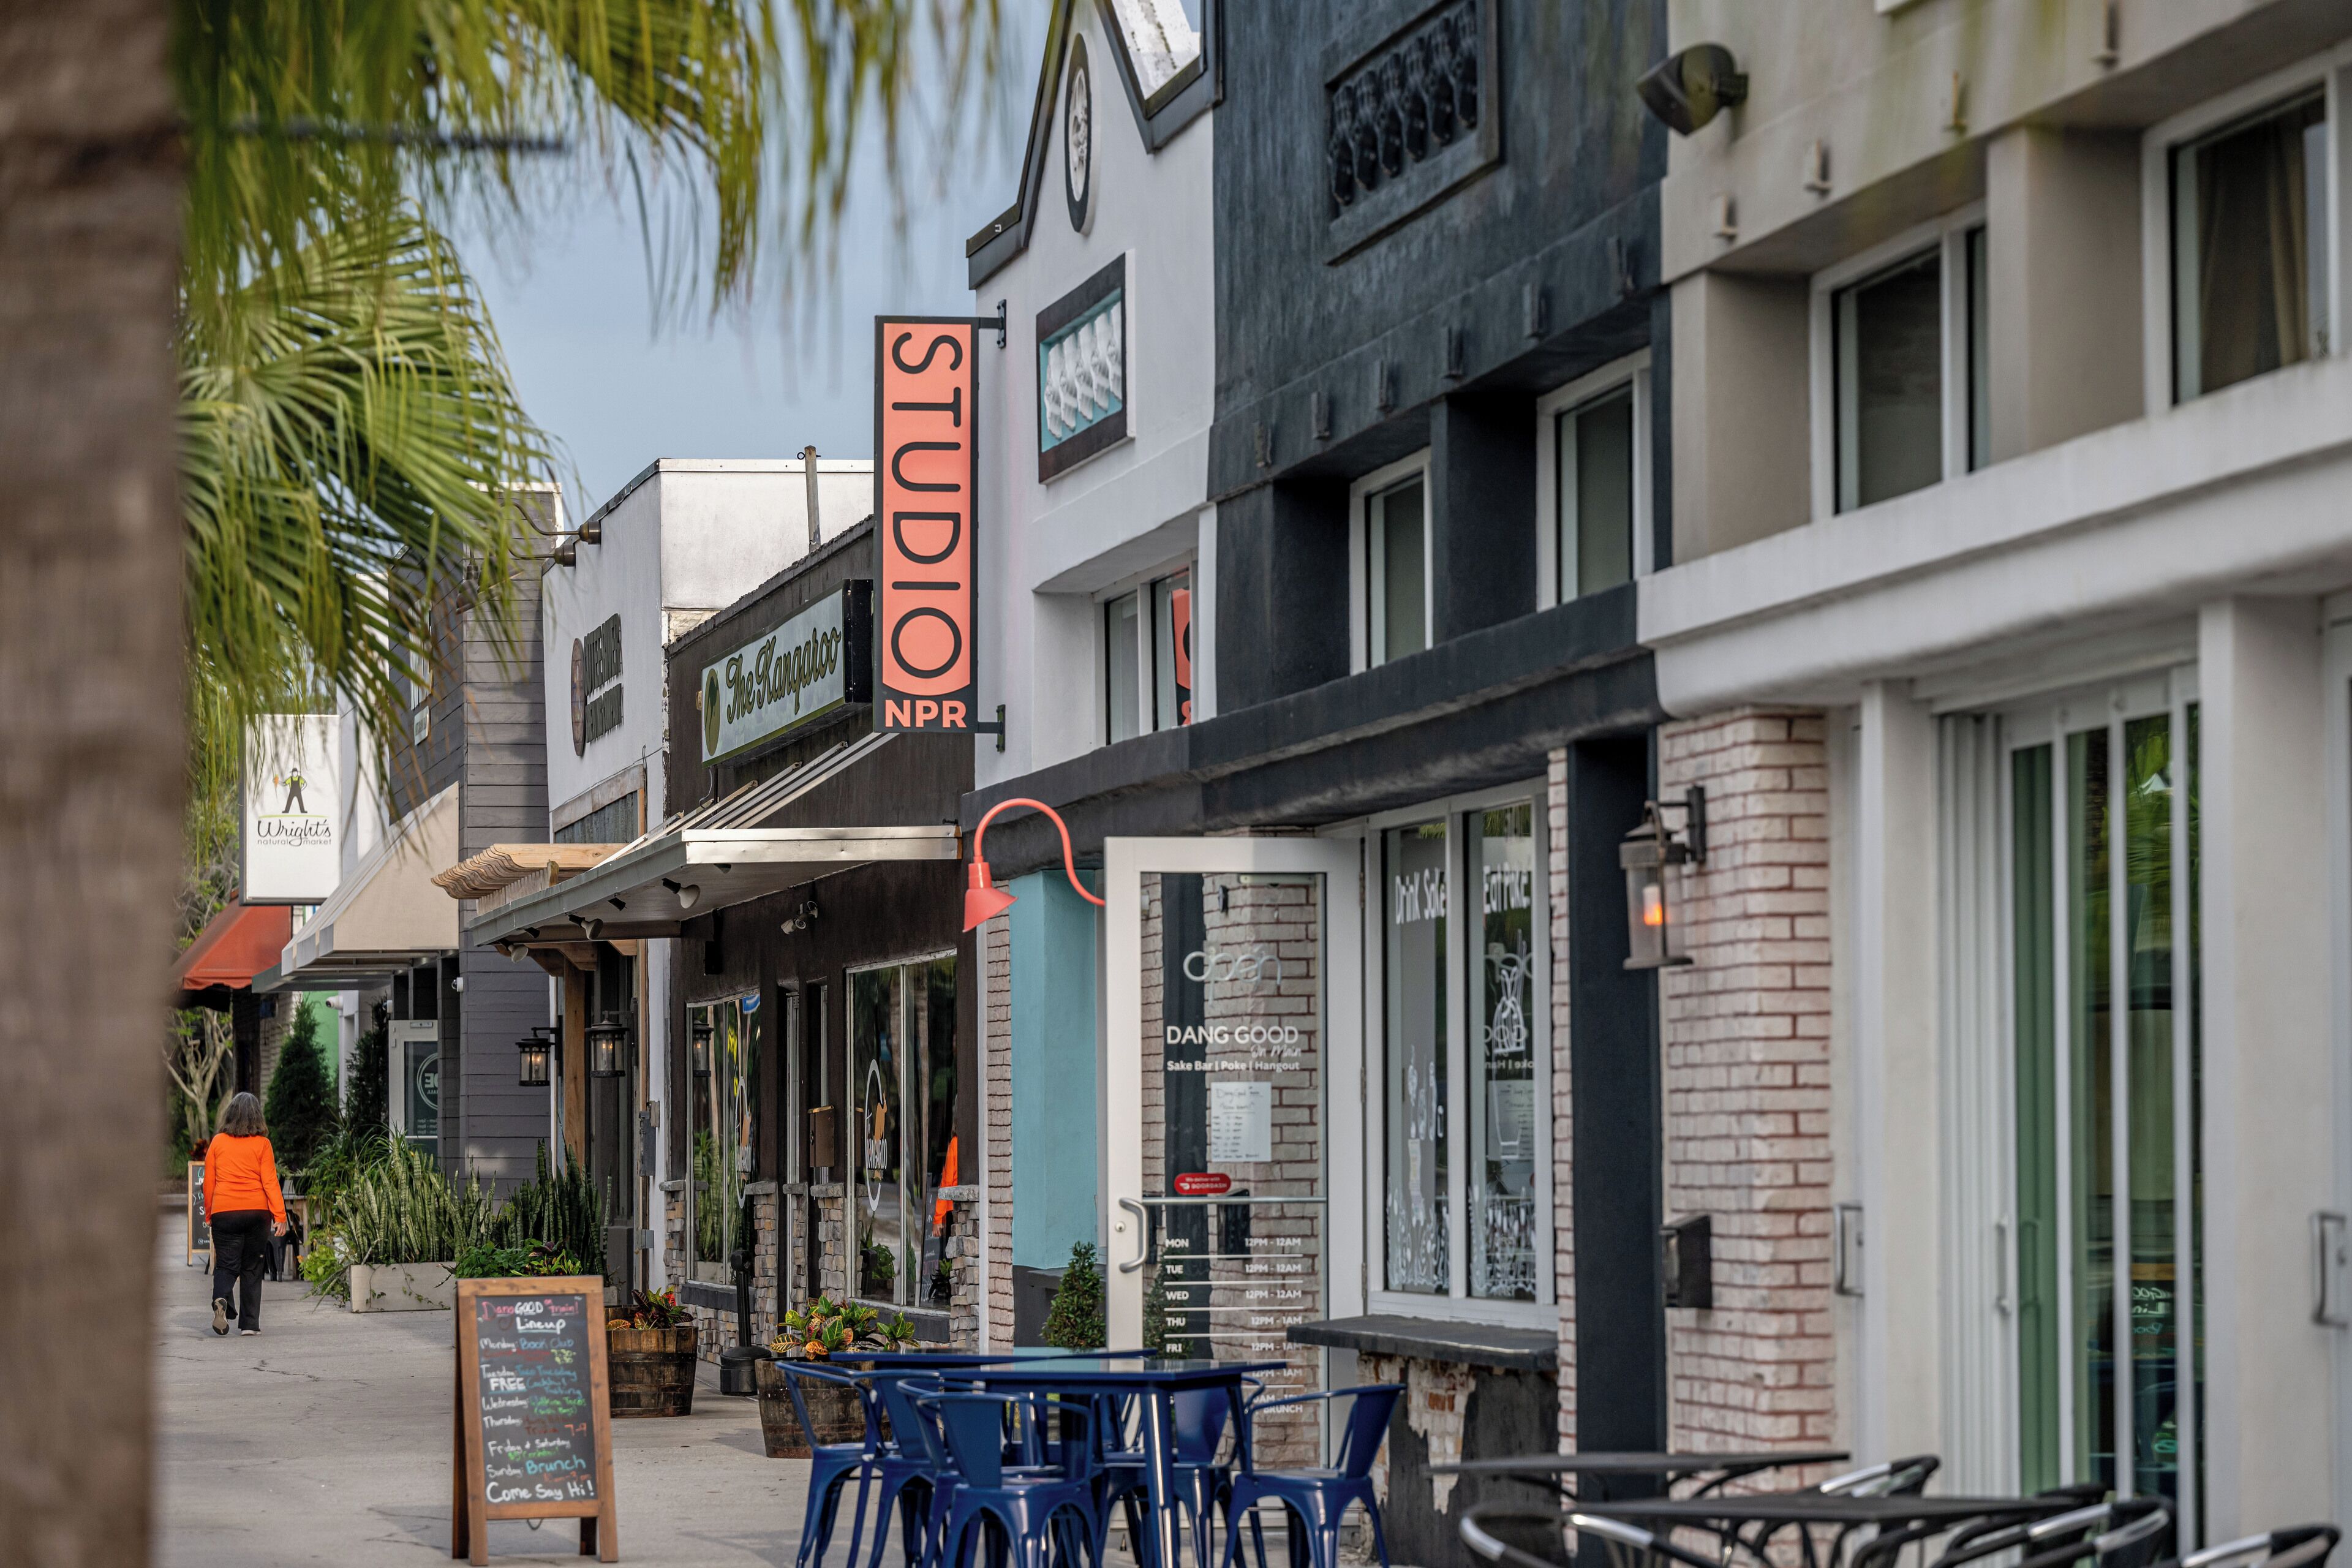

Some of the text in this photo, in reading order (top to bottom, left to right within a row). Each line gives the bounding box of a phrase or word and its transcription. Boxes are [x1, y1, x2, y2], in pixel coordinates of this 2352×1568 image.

[891, 331, 962, 678] STUDIO
[725, 627, 842, 724] The Kangaroo
[885, 699, 967, 728] NPR
[257, 819, 331, 846] Wright's
[1183, 951, 1282, 1008] open
[1166, 1025, 1299, 1044] DANG GOOD
[1270, 1044, 1302, 1058] Main
[1167, 1060, 1193, 1071] Sake
[1194, 1060, 1213, 1071] Bar
[1221, 1061, 1247, 1071] Poke
[1255, 1061, 1300, 1072] Hangout
[867, 1139, 888, 1169] KANGAROO
[1165, 1238, 1189, 1248] MON
[1245, 1238, 1268, 1247] 12PM
[1276, 1237, 1301, 1246] 12AM
[1166, 1265, 1183, 1275] TUE
[1245, 1264, 1268, 1273] 12PM
[1276, 1264, 1301, 1272] 12AM
[1166, 1291, 1189, 1300] WED
[1245, 1290, 1268, 1298] 12PM
[1276, 1289, 1302, 1298] 12AM
[514, 1300, 544, 1315] GOOD
[516, 1316, 567, 1335] Lineup
[1166, 1317, 1186, 1327] THU
[1251, 1316, 1273, 1325] 12PM
[1283, 1316, 1302, 1324] 1AM
[1166, 1343, 1183, 1353] FRI
[1251, 1342, 1274, 1351] 12PM
[1283, 1342, 1302, 1351] 1AM
[1283, 1368, 1302, 1377] 1AM
[489, 1378, 527, 1392] FREE
[488, 1439, 522, 1457] Friday
[535, 1438, 571, 1450] Saturday
[526, 1454, 586, 1475] Brunch
[486, 1482, 532, 1503] Come
[535, 1483, 564, 1501] Say
